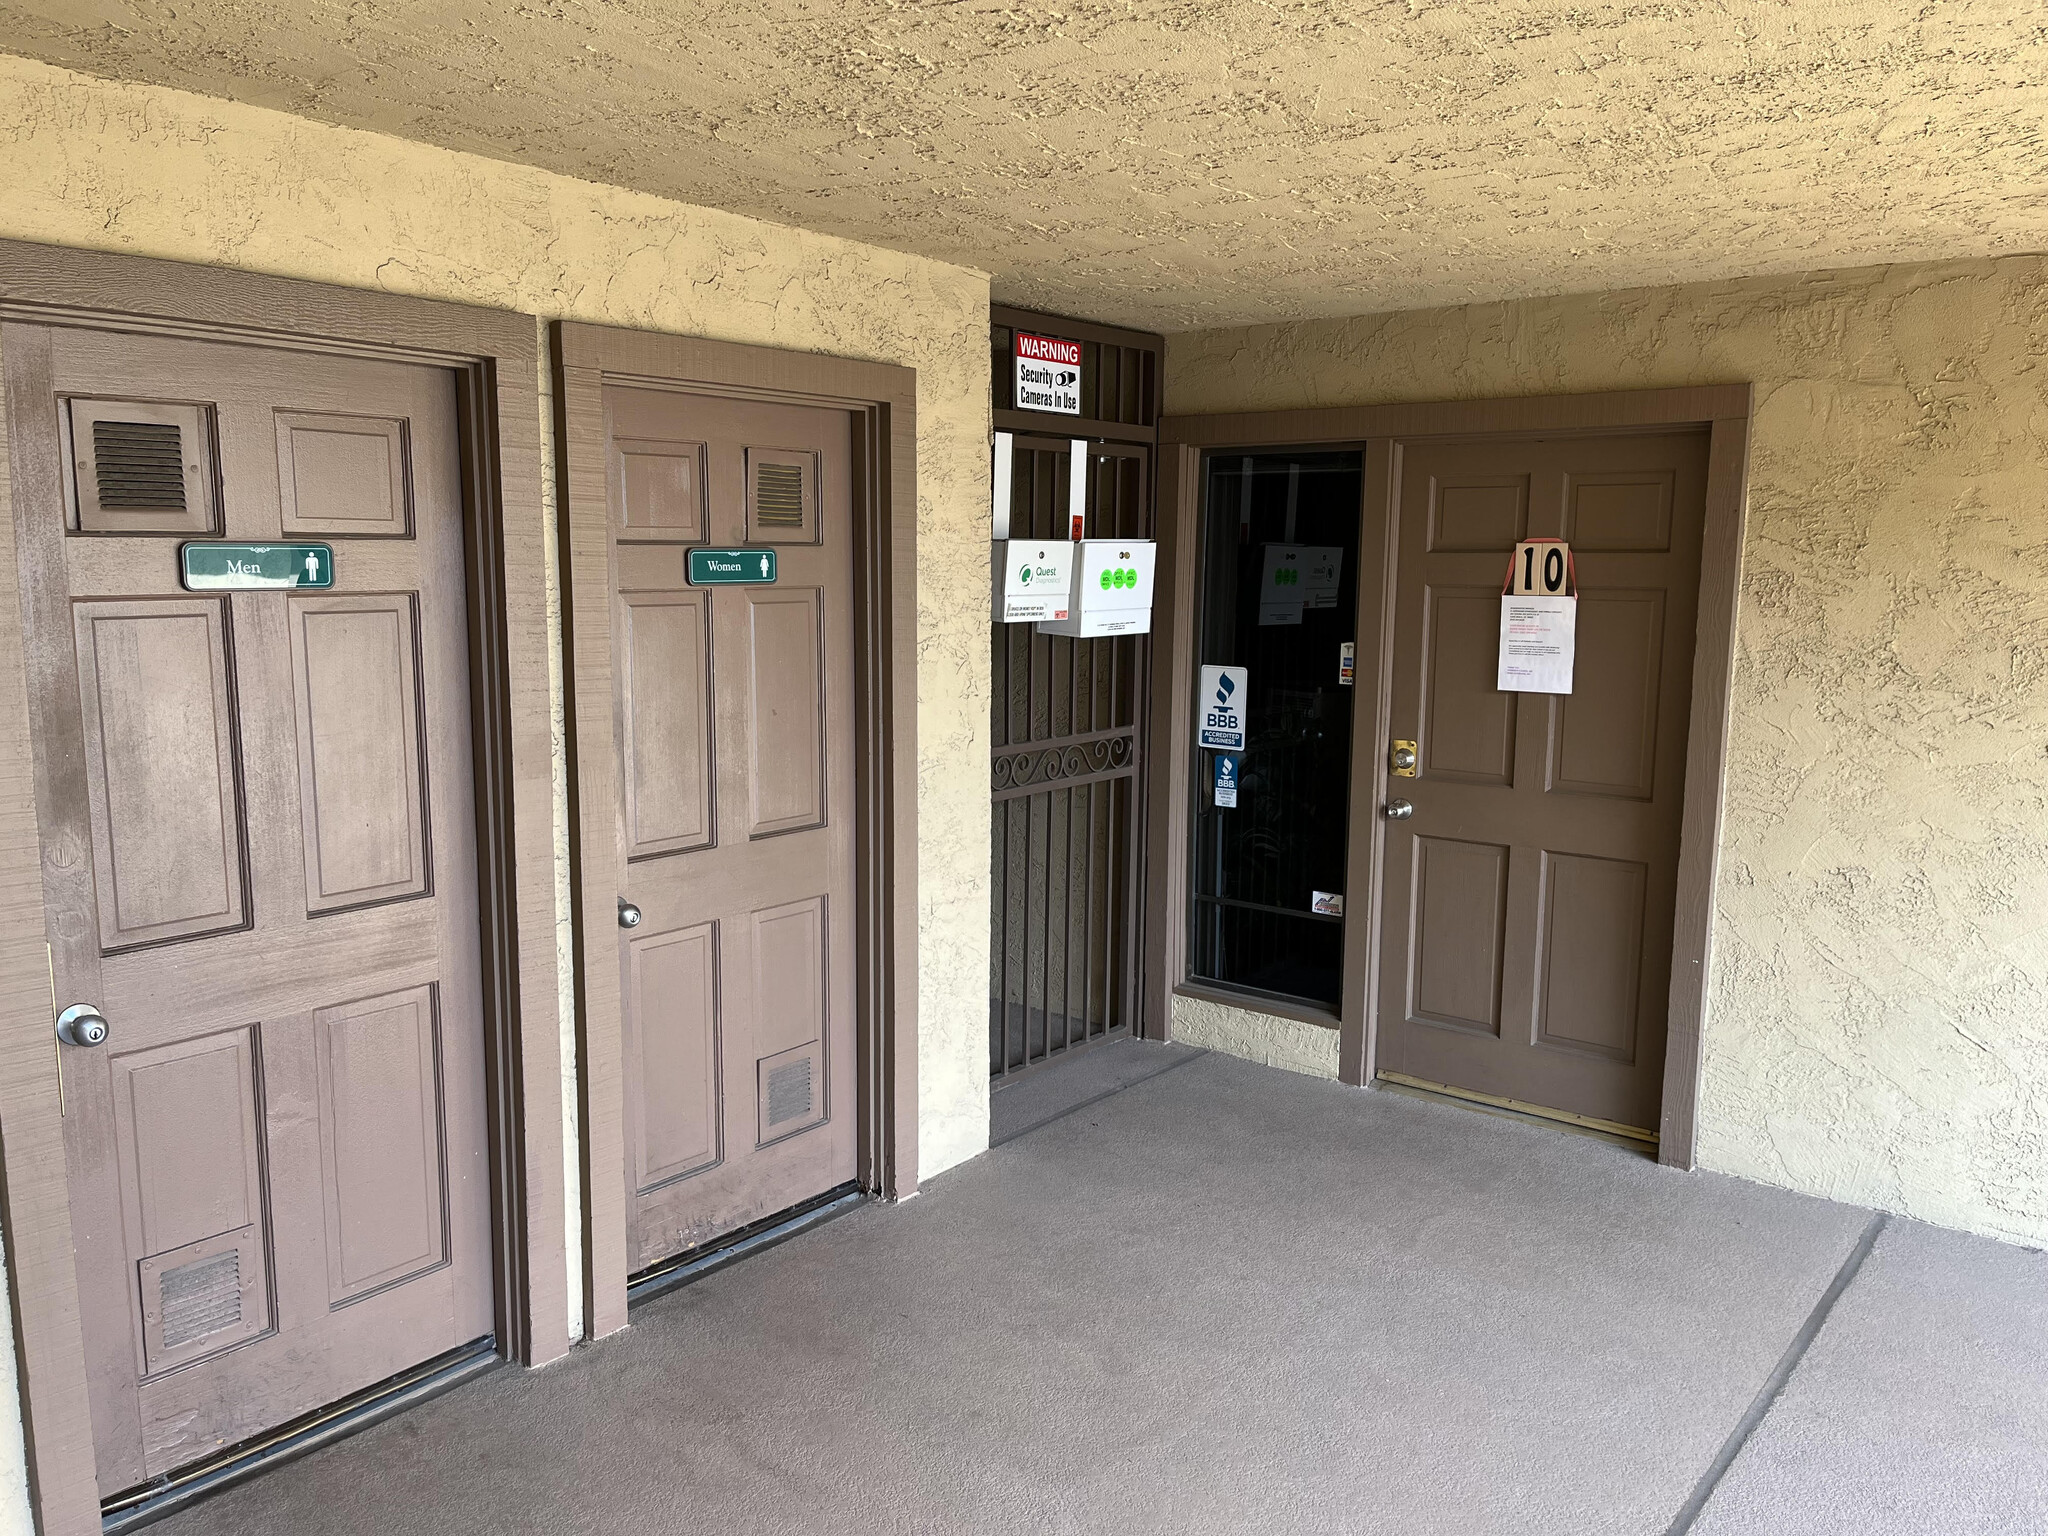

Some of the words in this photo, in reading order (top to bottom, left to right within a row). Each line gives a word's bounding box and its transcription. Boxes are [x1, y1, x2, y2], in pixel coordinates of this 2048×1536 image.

[1020, 336, 1078, 363] WARNING
[1020, 364, 1053, 389] Security
[1020, 386, 1052, 407] Cameras
[1054, 391, 1062, 408] In
[1063, 392, 1076, 410] Use
[226, 559, 261, 574] Men
[707, 560, 741, 571] Women
[1036, 566, 1056, 576] Quest
[1524, 547, 1563, 592] 10
[1207, 713, 1238, 729] BBB
[1204, 731, 1240, 740] ACCREDITED
[1208, 737, 1236, 745] BUSINESS
[1217, 779, 1234, 788] BBB
